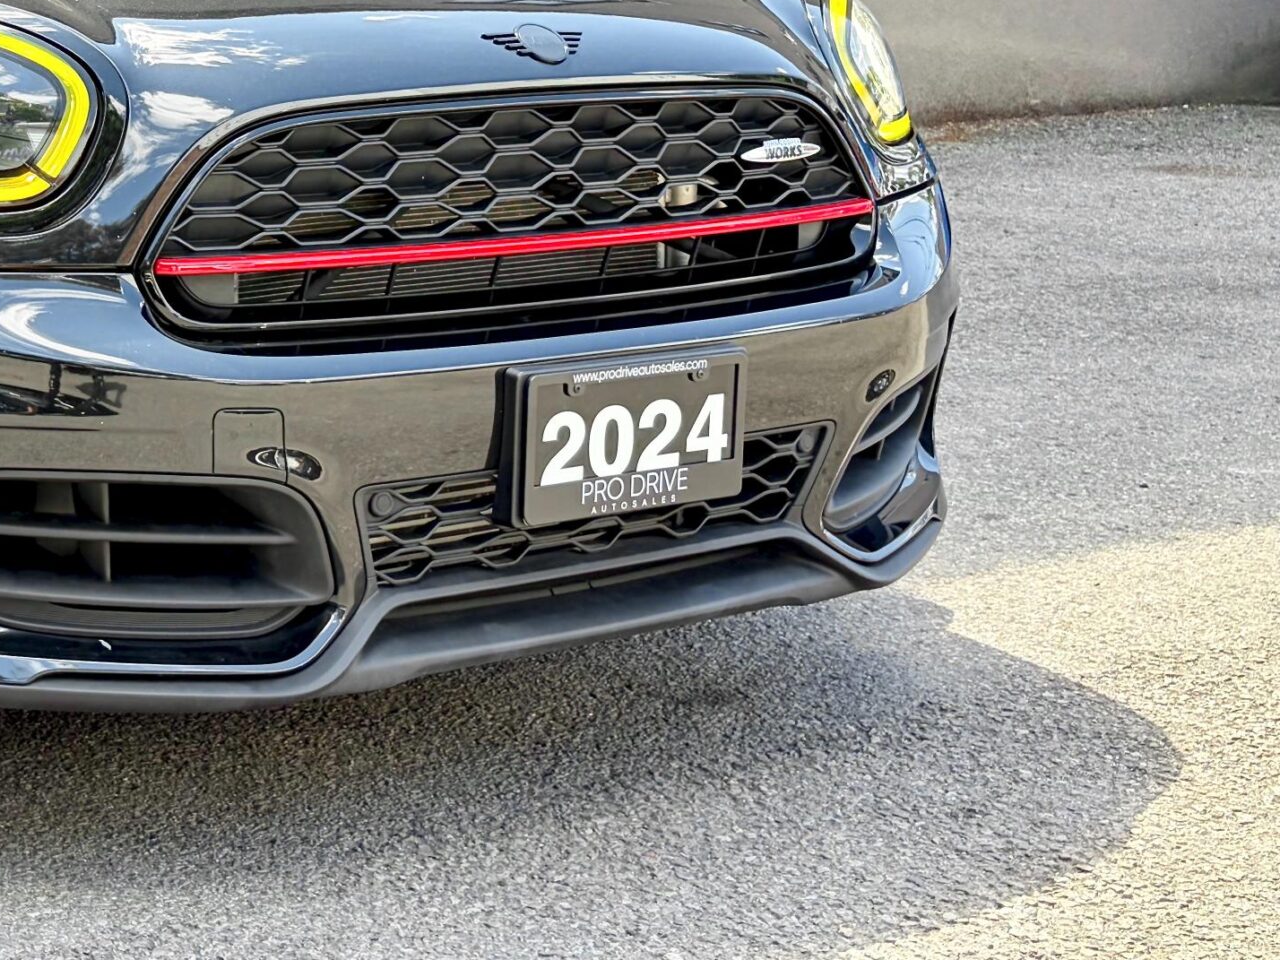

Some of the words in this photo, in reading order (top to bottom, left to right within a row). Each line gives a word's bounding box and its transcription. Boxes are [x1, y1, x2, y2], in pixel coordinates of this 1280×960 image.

[765, 144, 802, 160] WORKS
[572, 359, 708, 383] www.prodriveautosales.com
[540, 393, 728, 486] 2024
[582, 477, 624, 505] PRO
[630, 468, 689, 498] DRIVE
[590, 494, 676, 515] AUTOSALES
